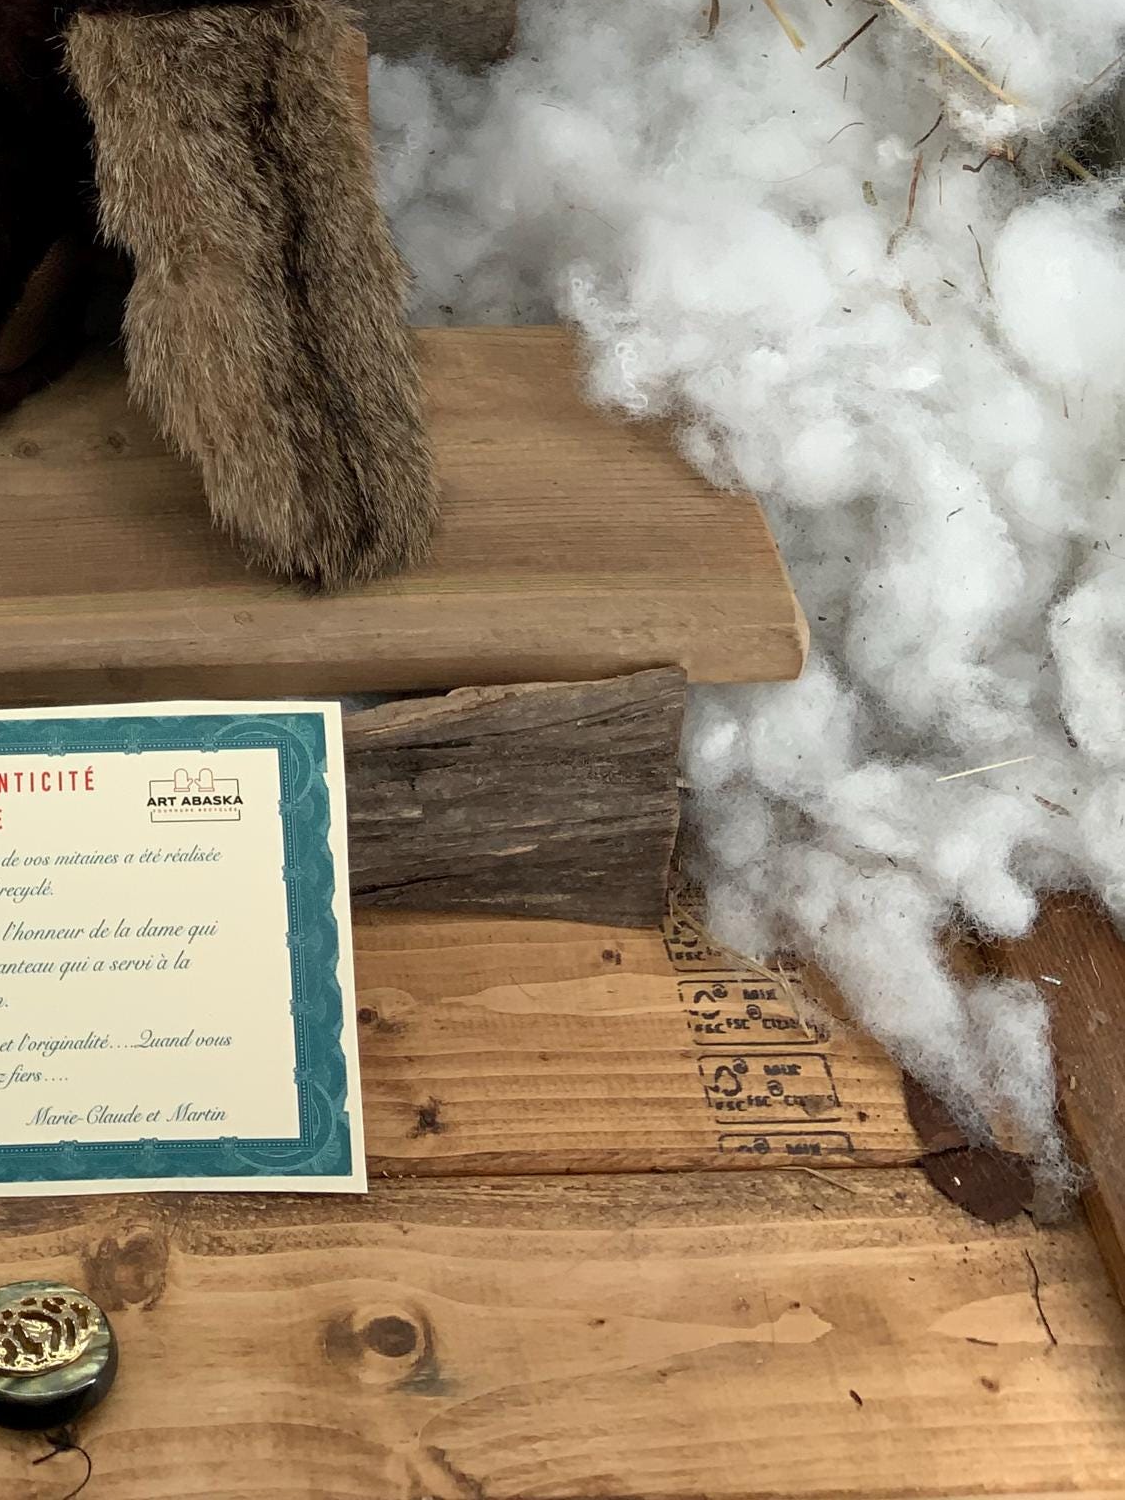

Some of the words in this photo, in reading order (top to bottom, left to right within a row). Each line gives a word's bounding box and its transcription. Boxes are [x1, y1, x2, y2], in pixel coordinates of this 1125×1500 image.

[147, 797, 177, 807] ART
[181, 795, 244, 806] ABASKA
[1, 849, 20, 868] de
[25, 853, 50, 867] vos
[54, 850, 120, 866] mitaines
[123, 853, 135, 864] a
[139, 848, 163, 863] été
[164, 844, 222, 862] réalisée
[2, 920, 85, 942] l'honneur
[89, 918, 110, 938] de
[114, 917, 132, 938] la
[136, 917, 184, 937] dame
[187, 920, 218, 944] qui
[59, 956, 90, 980] qui
[93, 959, 105, 972] a
[109, 954, 154, 972] servi
[156, 953, 169, 970] à
[173, 950, 192, 970] la
[0, 1038, 14, 1052] et
[195, 1035, 233, 1047] vous
[25, 1104, 143, 1127] Marie-Claude
[146, 1109, 161, 1123] et
[165, 1101, 228, 1124] Martin
